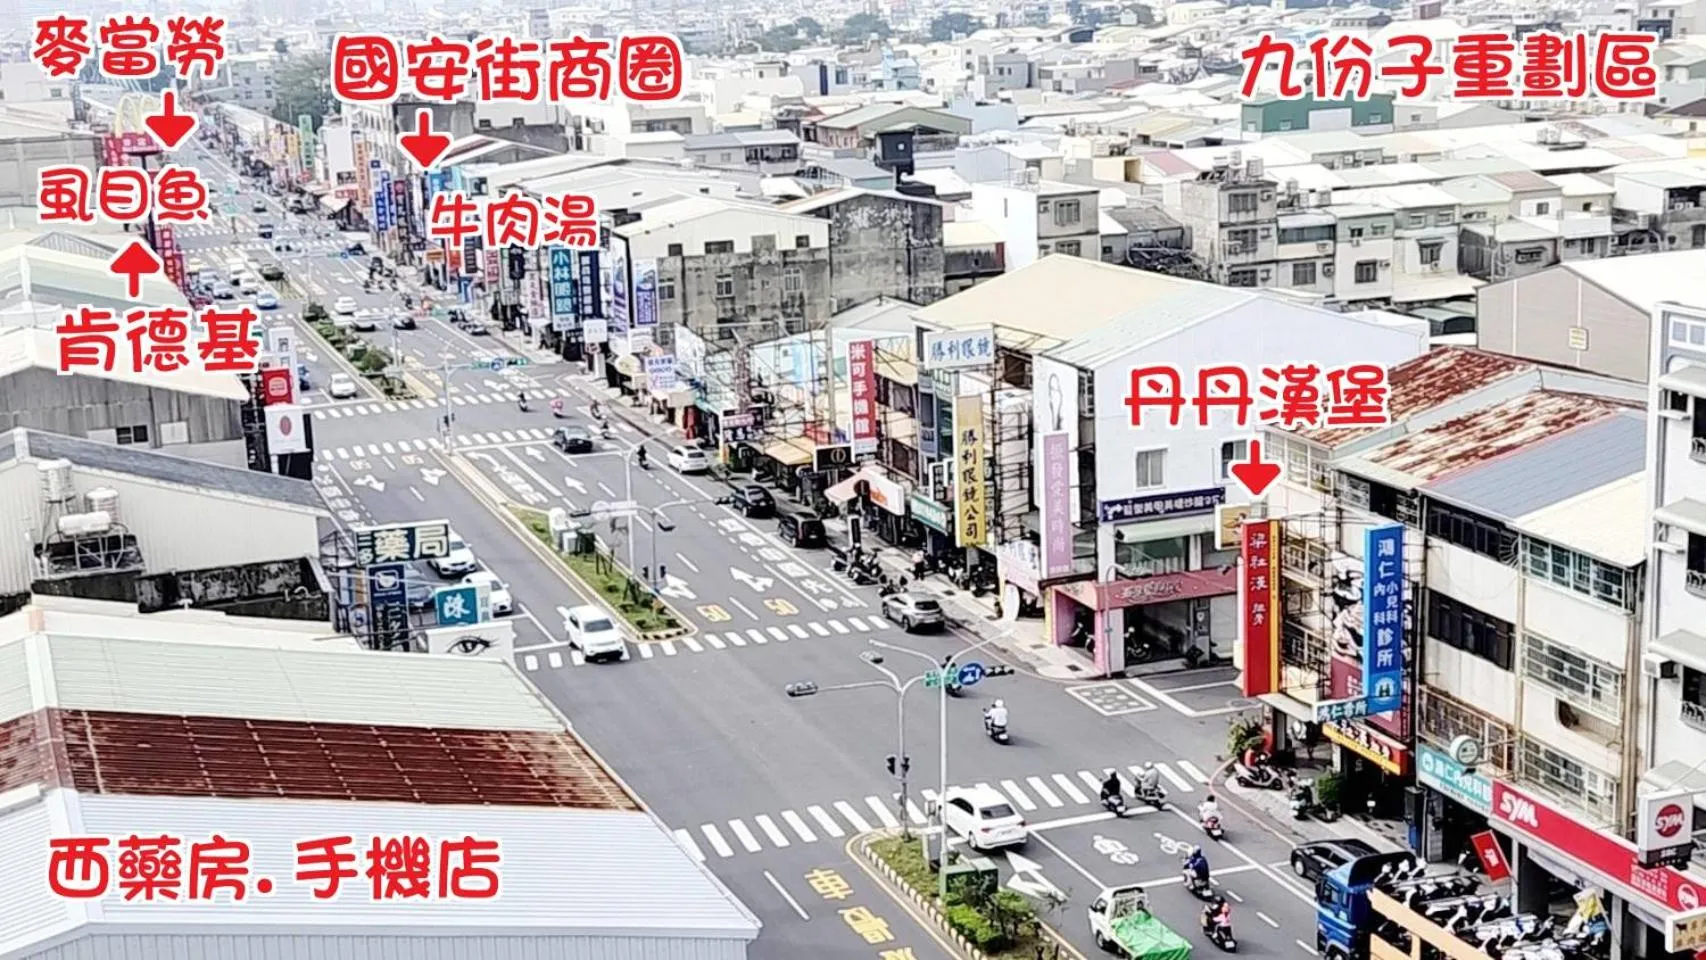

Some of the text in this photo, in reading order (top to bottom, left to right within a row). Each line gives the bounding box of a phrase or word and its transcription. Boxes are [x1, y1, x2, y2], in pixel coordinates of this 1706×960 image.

[929, 336, 992, 362] 勝利眼鏡
[850, 343, 870, 435] 米可手機館
[374, 525, 449, 563] 藥局
[1499, 791, 1539, 829] SYM
[1654, 813, 1684, 832] SYM
